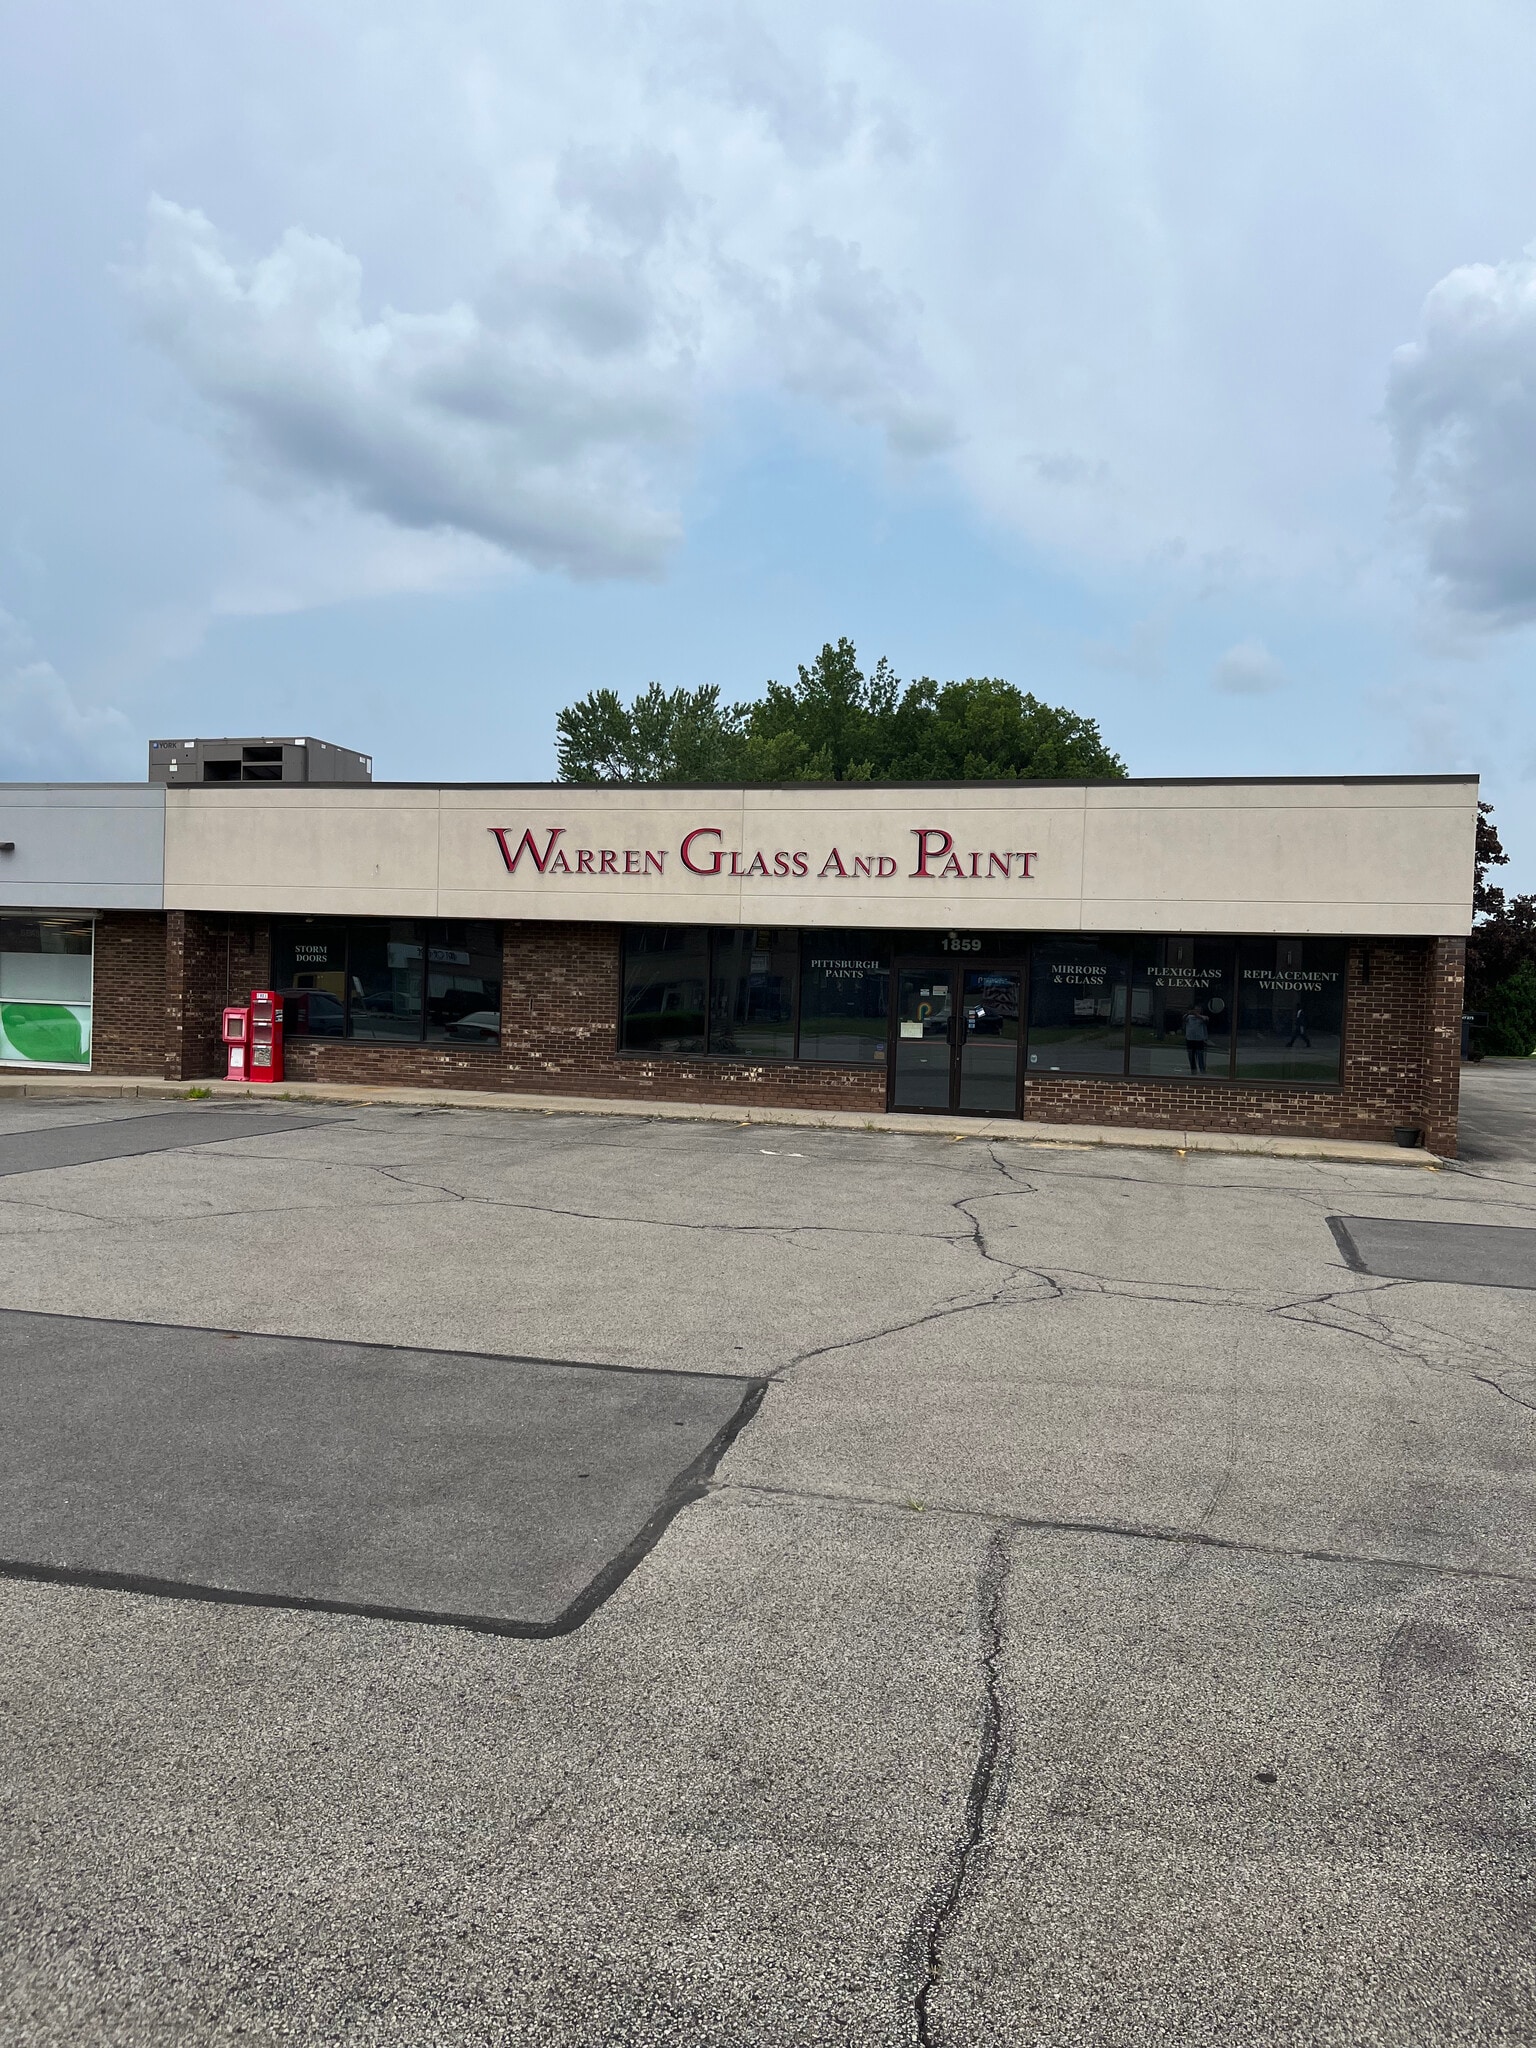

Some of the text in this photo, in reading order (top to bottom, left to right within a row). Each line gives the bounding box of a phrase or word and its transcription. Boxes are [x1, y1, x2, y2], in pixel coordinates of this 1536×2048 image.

[295, 945, 327, 953] STORM
[941, 938, 982, 951] 1859
[296, 954, 327, 962] DOORS
[811, 959, 879, 969] PITTSBURGH
[825, 969, 864, 979] PAINTS
[1051, 965, 1107, 975] MIRRORS
[1147, 967, 1222, 978] PLEXIGLASS
[1053, 975, 1104, 985] & GLASS
[1243, 970, 1339, 982] REPLACEMENT
[1155, 977, 1210, 988] & LEXAN
[1259, 981, 1322, 992] WINDOWS
